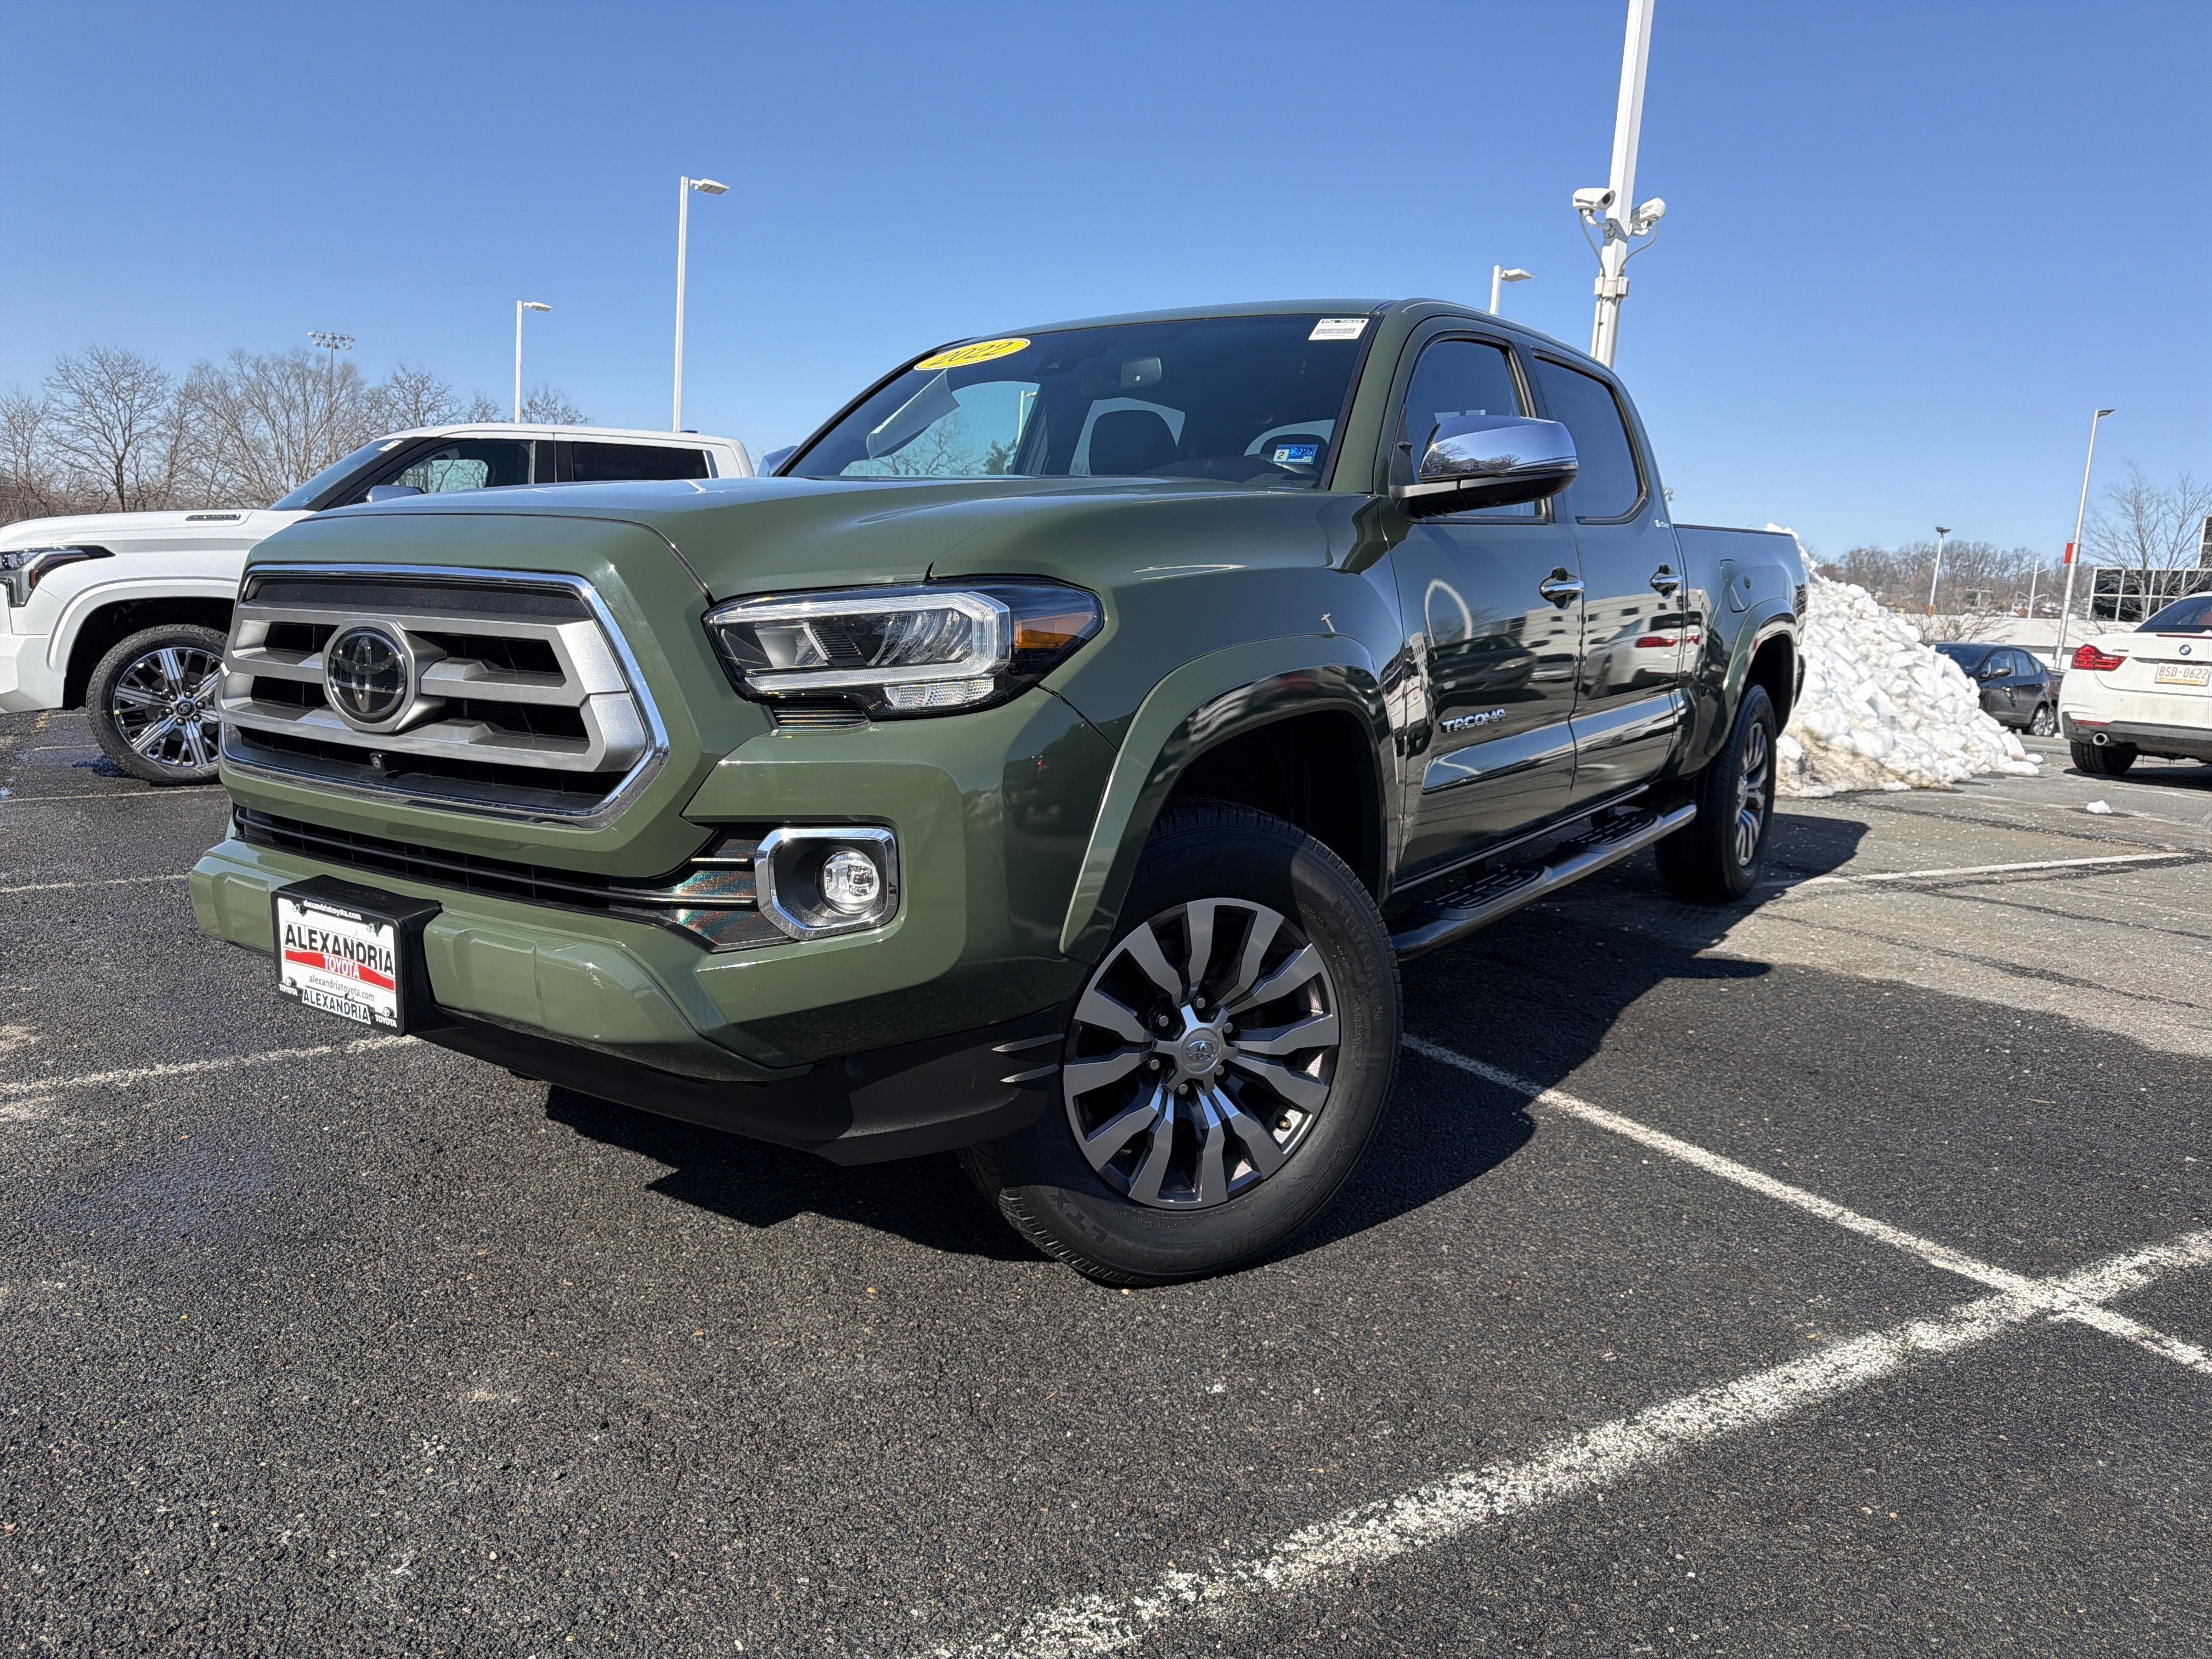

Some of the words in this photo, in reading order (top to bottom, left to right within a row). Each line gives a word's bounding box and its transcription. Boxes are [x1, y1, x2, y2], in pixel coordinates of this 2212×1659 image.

[927, 342, 1014, 367] 2022
[2159, 666, 2209, 679] BSD-0622
[1441, 708, 1506, 732] TACOMA
[303, 900, 362, 921] alexandriatoyota.com
[284, 923, 394, 975] ALEXANDRIA
[323, 955, 360, 979] TOYOTA
[279, 984, 298, 996] TOYOTA
[309, 974, 374, 1002] alexandriatoyota.com
[303, 989, 370, 1022] ALEXANDRIA
[375, 1015, 397, 1028] TOYOTA
